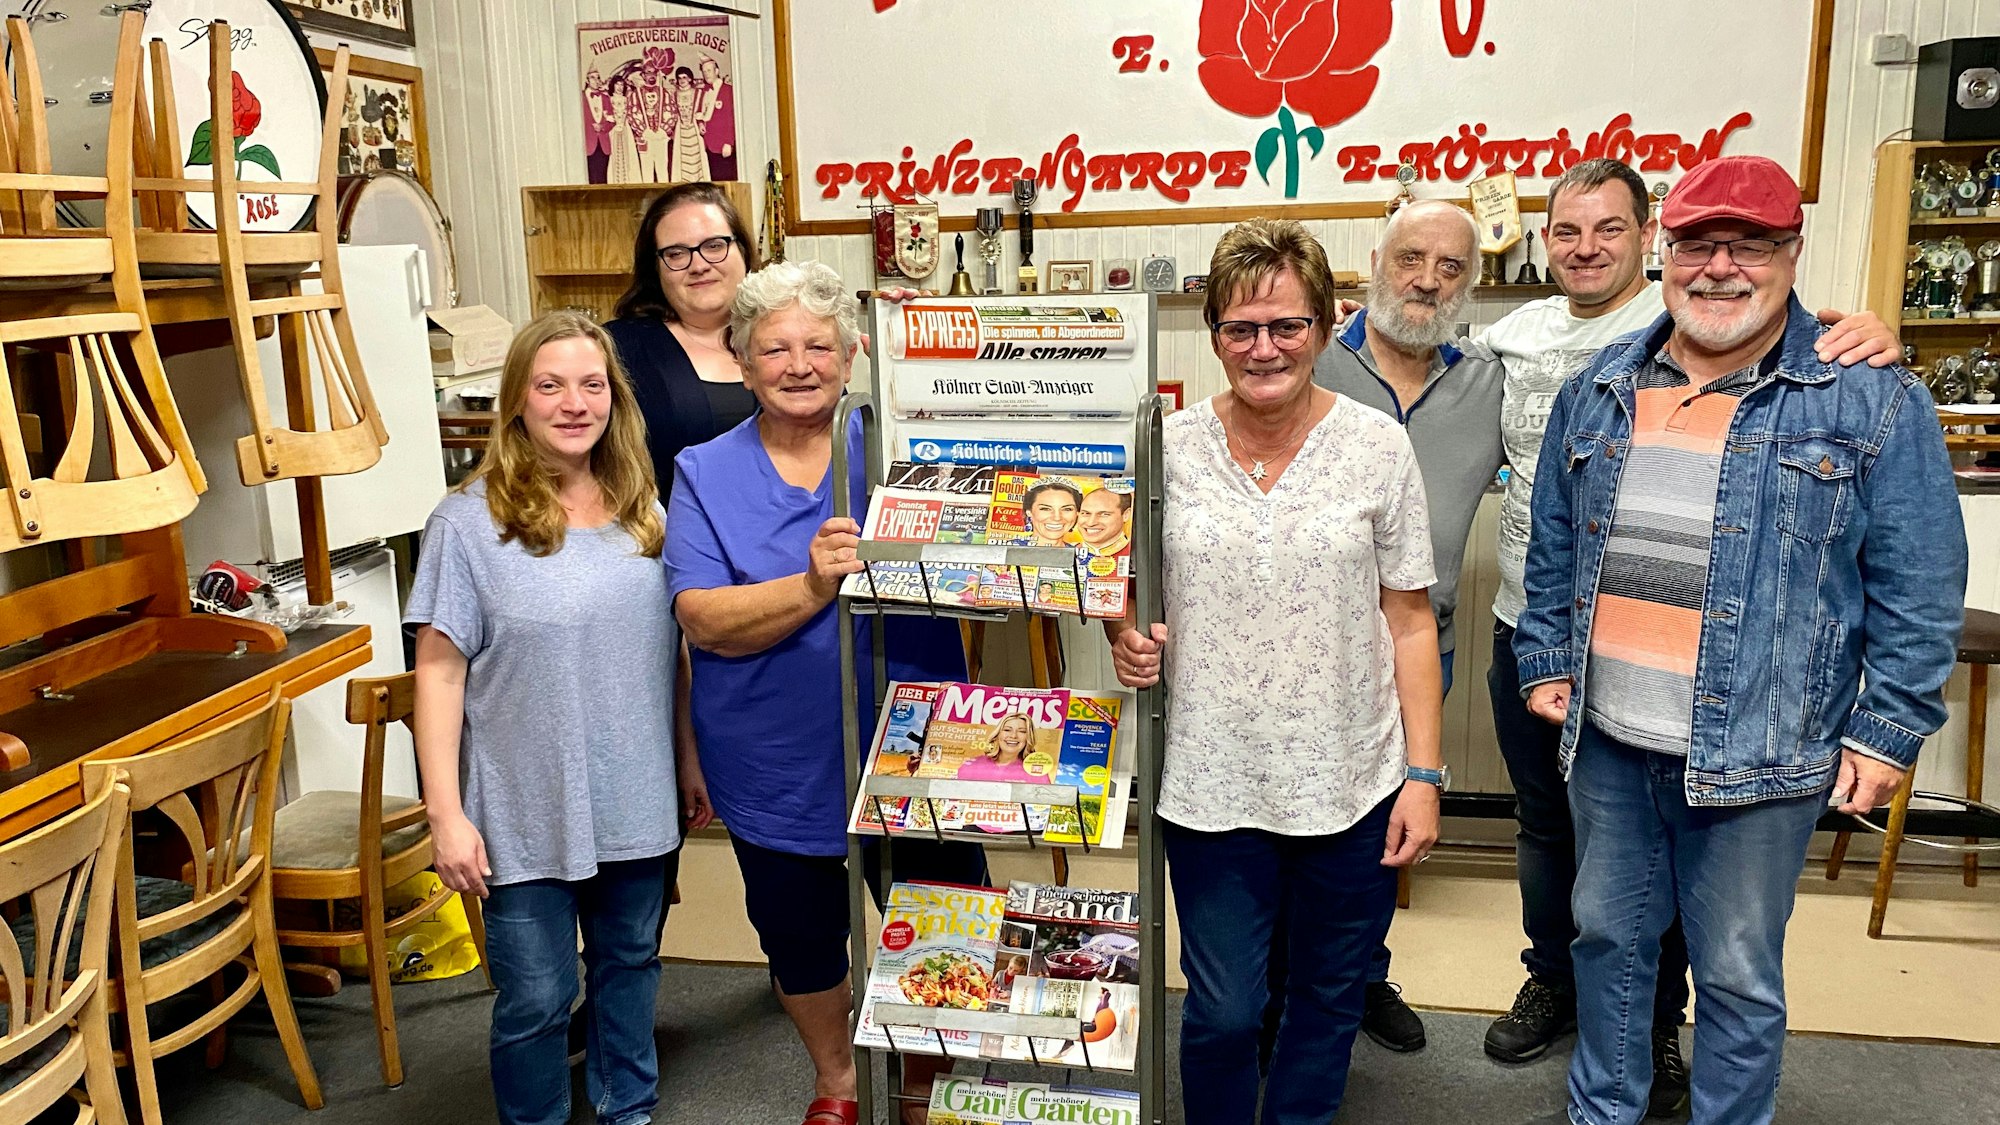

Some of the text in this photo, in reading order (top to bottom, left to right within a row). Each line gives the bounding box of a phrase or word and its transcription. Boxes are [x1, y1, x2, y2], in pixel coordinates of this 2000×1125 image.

[590, 29, 689, 55] THEATERVEREIN
[908, 310, 977, 350] EXPRESS
[984, 326, 1124, 340] Die spinnen, die Abgeordneten!
[978, 342, 1025, 360] Alle
[932, 378, 982, 396] Kölner
[896, 501, 927, 510] Sonntag
[944, 506, 987, 516] FC versinkt
[996, 506, 1018, 516] Kate
[877, 508, 938, 539] EXPRESS
[954, 514, 978, 523] Keller
[991, 522, 1024, 532] William
[896, 688, 924, 700] DER
[939, 685, 1062, 729] Meins
[947, 726, 987, 735] SCHLAFEN
[970, 740, 994, 750] 50+
[964, 810, 1018, 824] guttut
[891, 887, 1006, 917] essen &
[1042, 888, 1120, 903] mein schönes
[1024, 886, 1138, 924] Land
[1018, 1087, 1132, 1125] Garten
[1052, 1096, 1085, 1105] schöner
